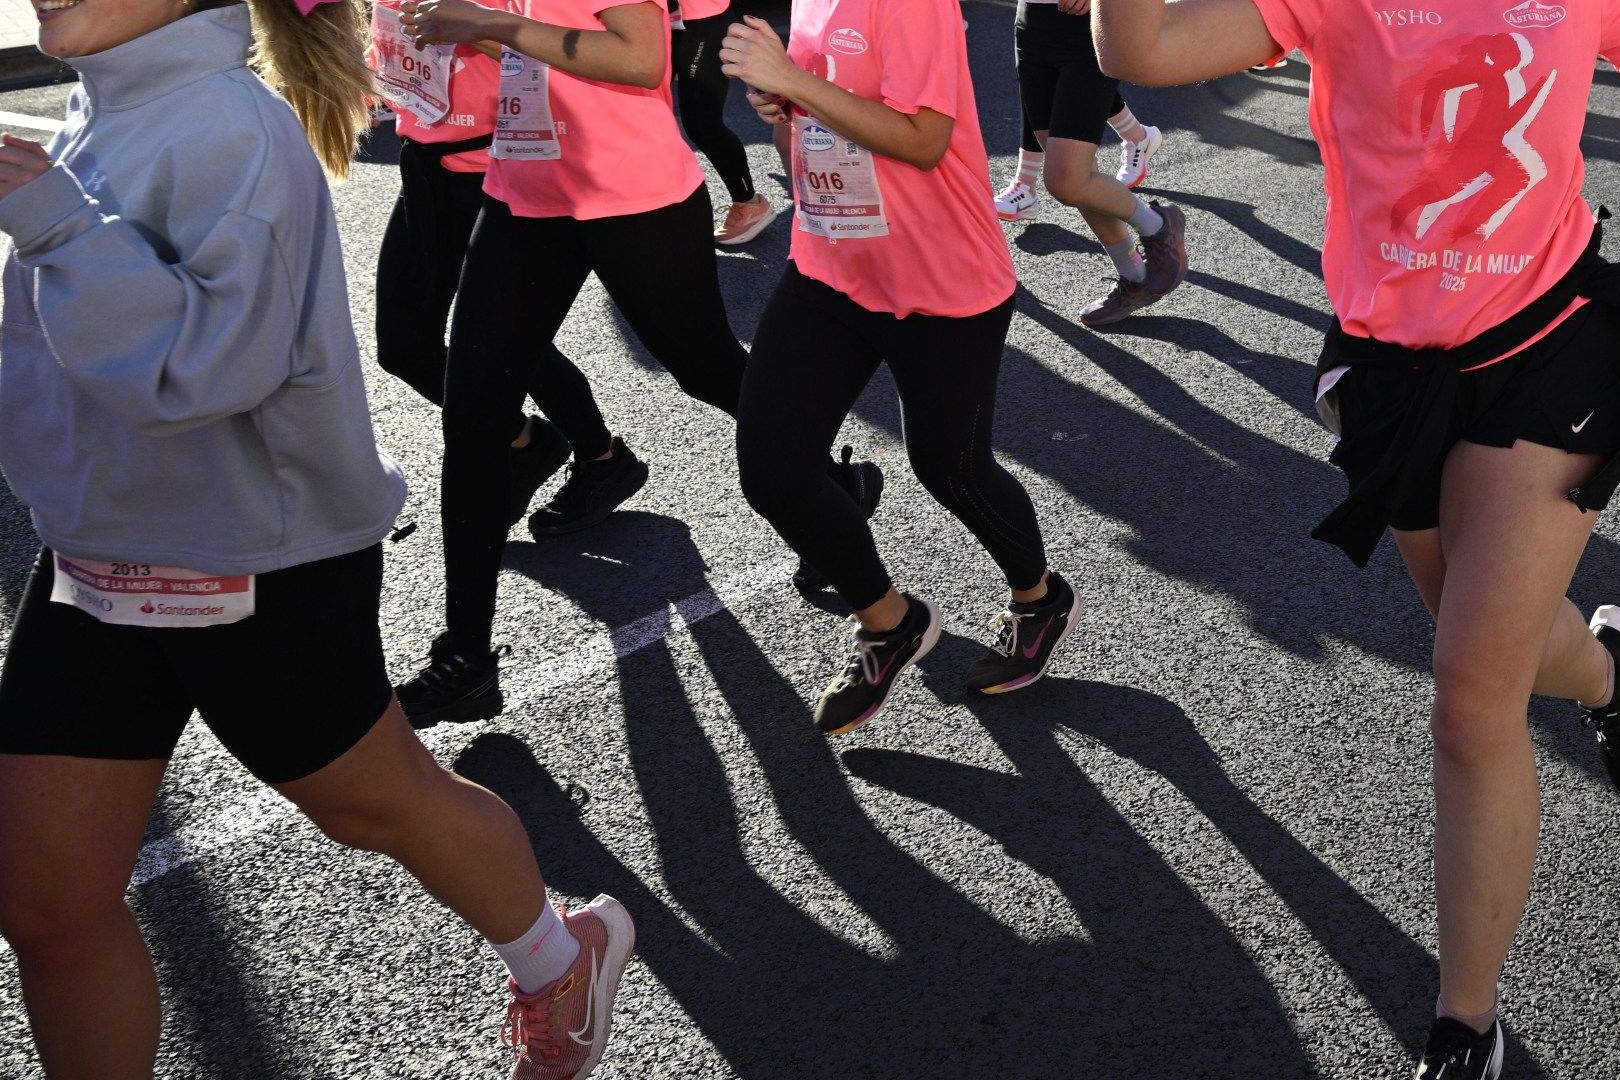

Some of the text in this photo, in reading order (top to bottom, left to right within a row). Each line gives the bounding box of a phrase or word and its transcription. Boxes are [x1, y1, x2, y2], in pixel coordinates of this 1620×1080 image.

[1509, 12, 1562, 24] ASTURIANA
[402, 56, 432, 80] 016
[808, 171, 844, 190] 016
[837, 223, 871, 232] Santander
[1443, 249, 1463, 271] DE
[1464, 254, 1482, 274] LA
[1439, 272, 1467, 292] 2025
[111, 562, 150, 576] 2013
[99, 578, 110, 588] DE
[111, 579, 123, 589] LA
[126, 580, 163, 591] MUJER
[170, 581, 221, 591] VALENCIA
[156, 602, 225, 616] Santander
